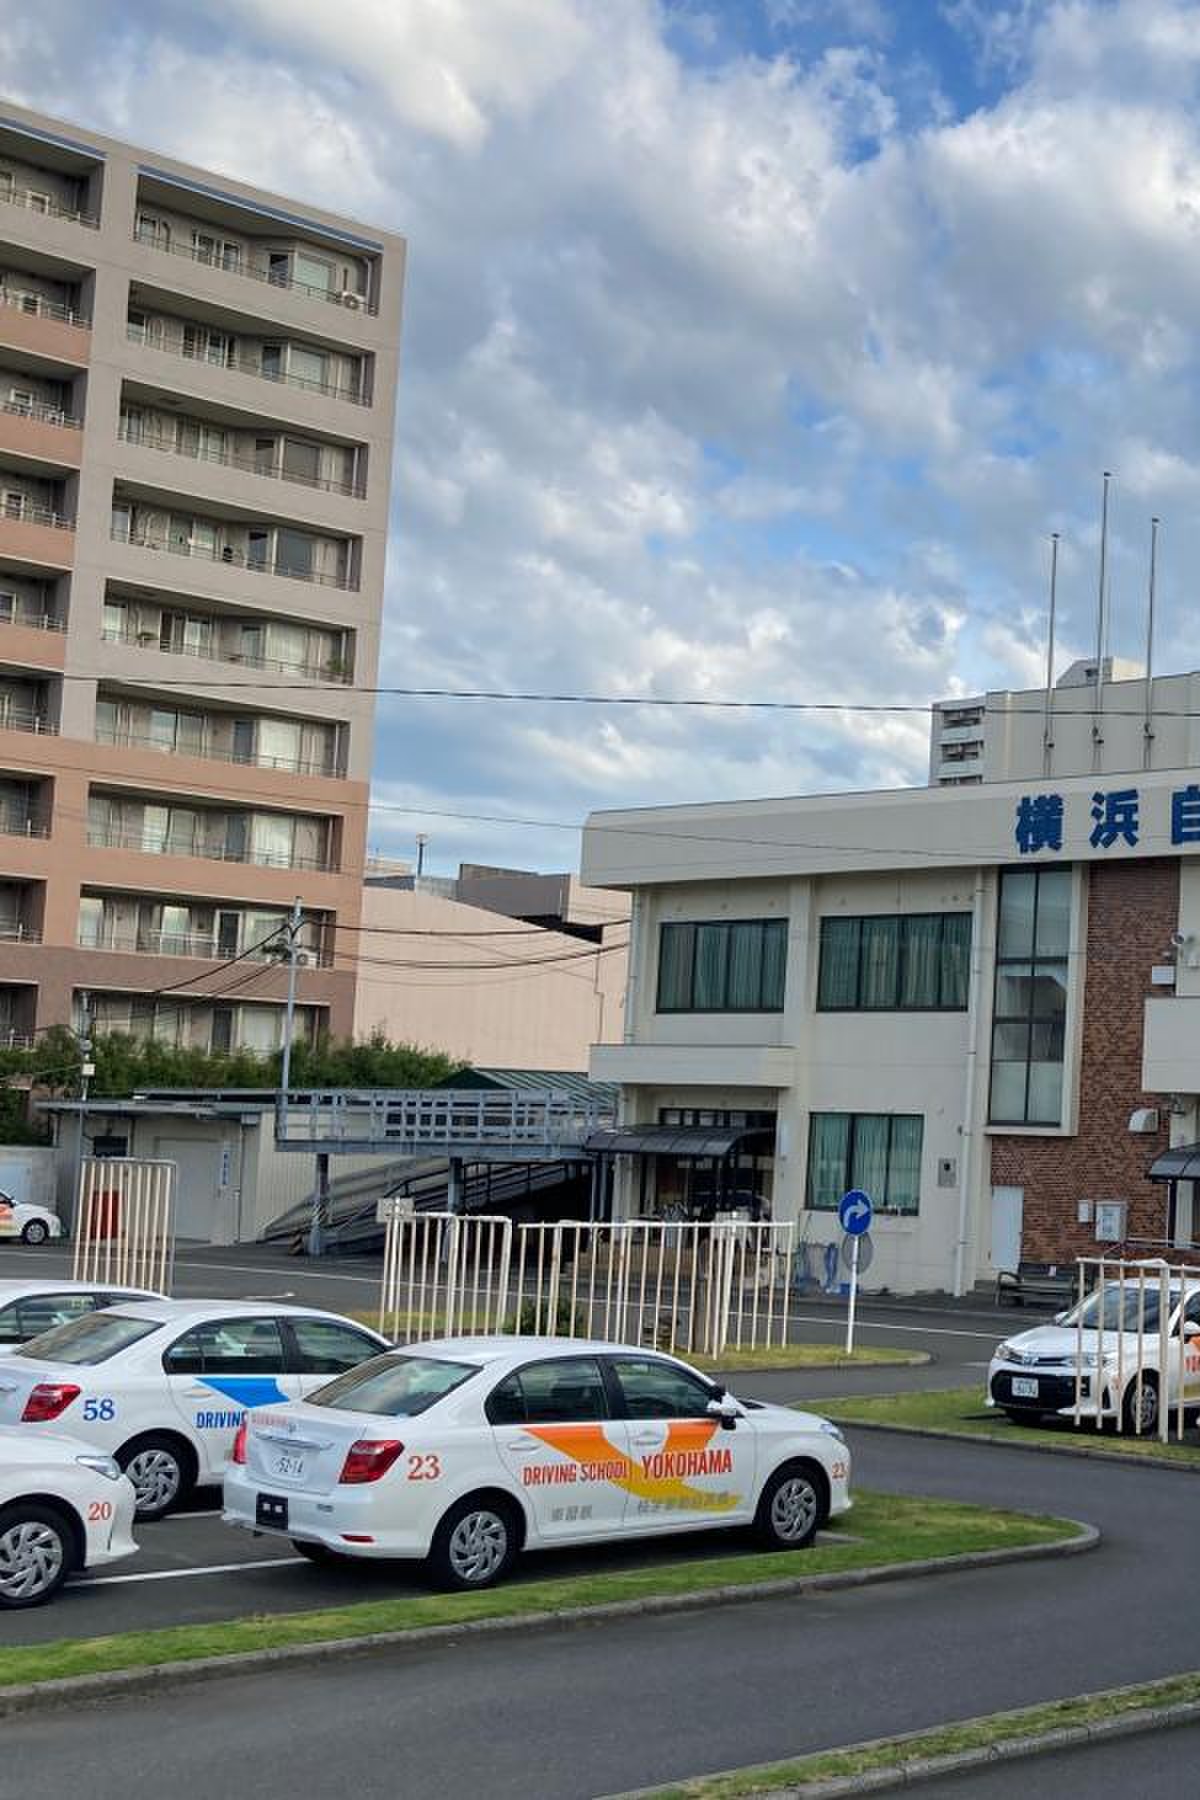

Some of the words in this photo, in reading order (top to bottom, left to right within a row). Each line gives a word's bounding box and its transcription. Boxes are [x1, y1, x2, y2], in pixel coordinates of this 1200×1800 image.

[82, 1397, 116, 1422] 58
[408, 1454, 440, 1481] 23
[523, 1461, 577, 1486] DRIVING
[580, 1459, 628, 1479] SCHOOL
[641, 1448, 733, 1479] YOKOHAMA
[88, 1501, 112, 1522] 20
